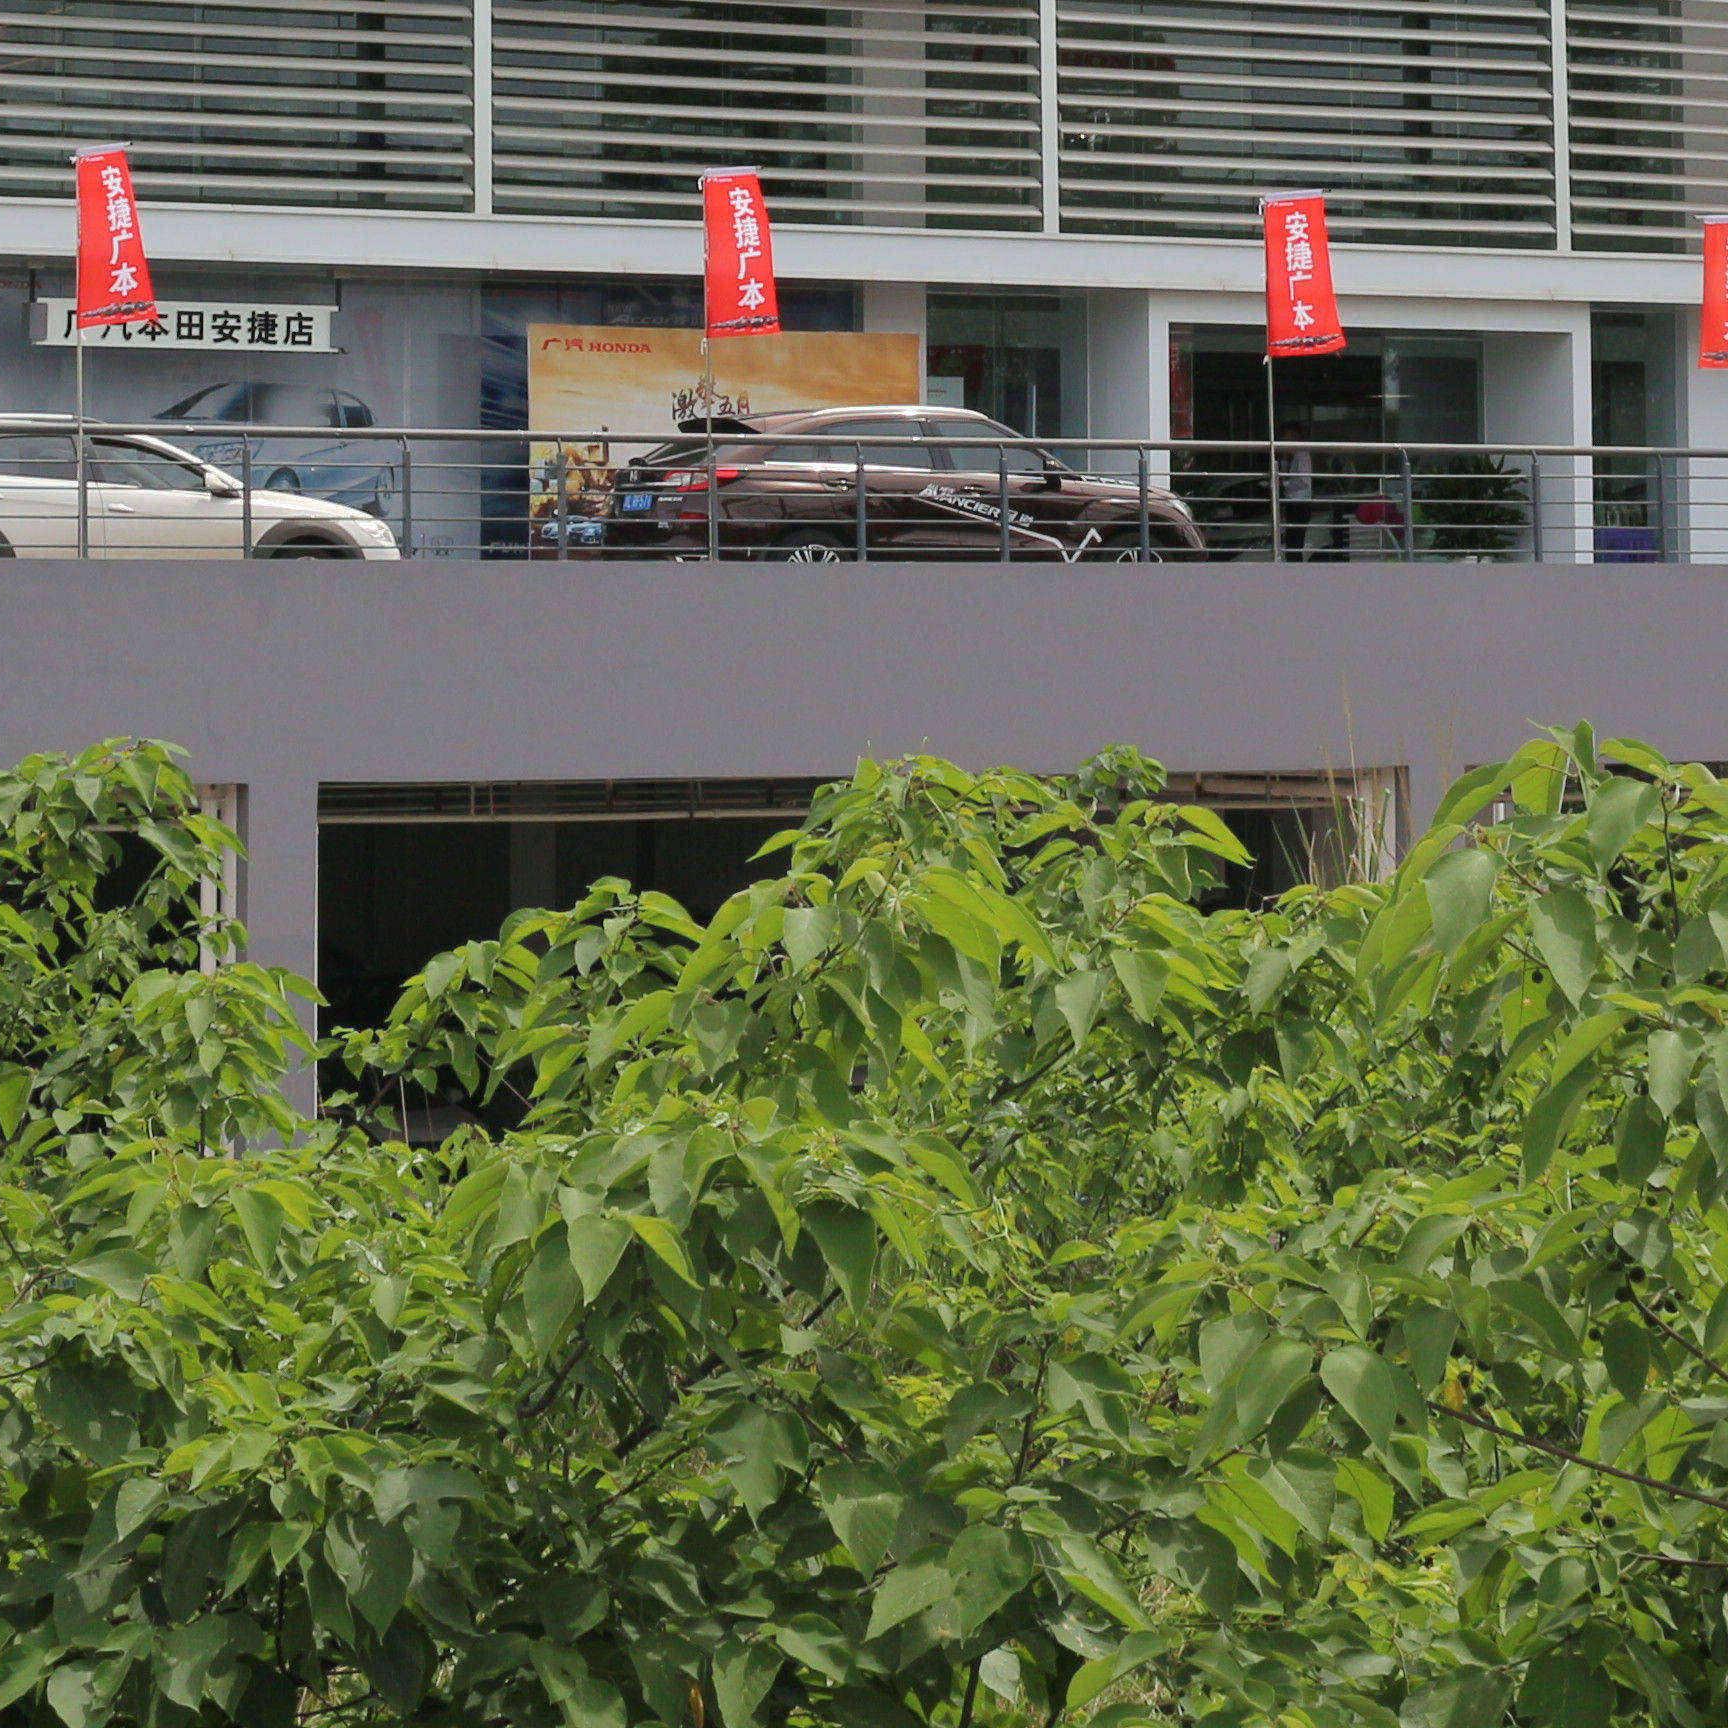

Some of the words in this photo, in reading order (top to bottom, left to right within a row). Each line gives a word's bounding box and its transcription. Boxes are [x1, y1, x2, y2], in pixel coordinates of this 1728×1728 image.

[101, 165, 138, 297] 安捷广本
[728, 187, 765, 310] 安捷广本
[1284, 212, 1315, 331] 安捷广本
[541, 338, 584, 352] 广汽
[588, 341, 653, 354] HONDA
